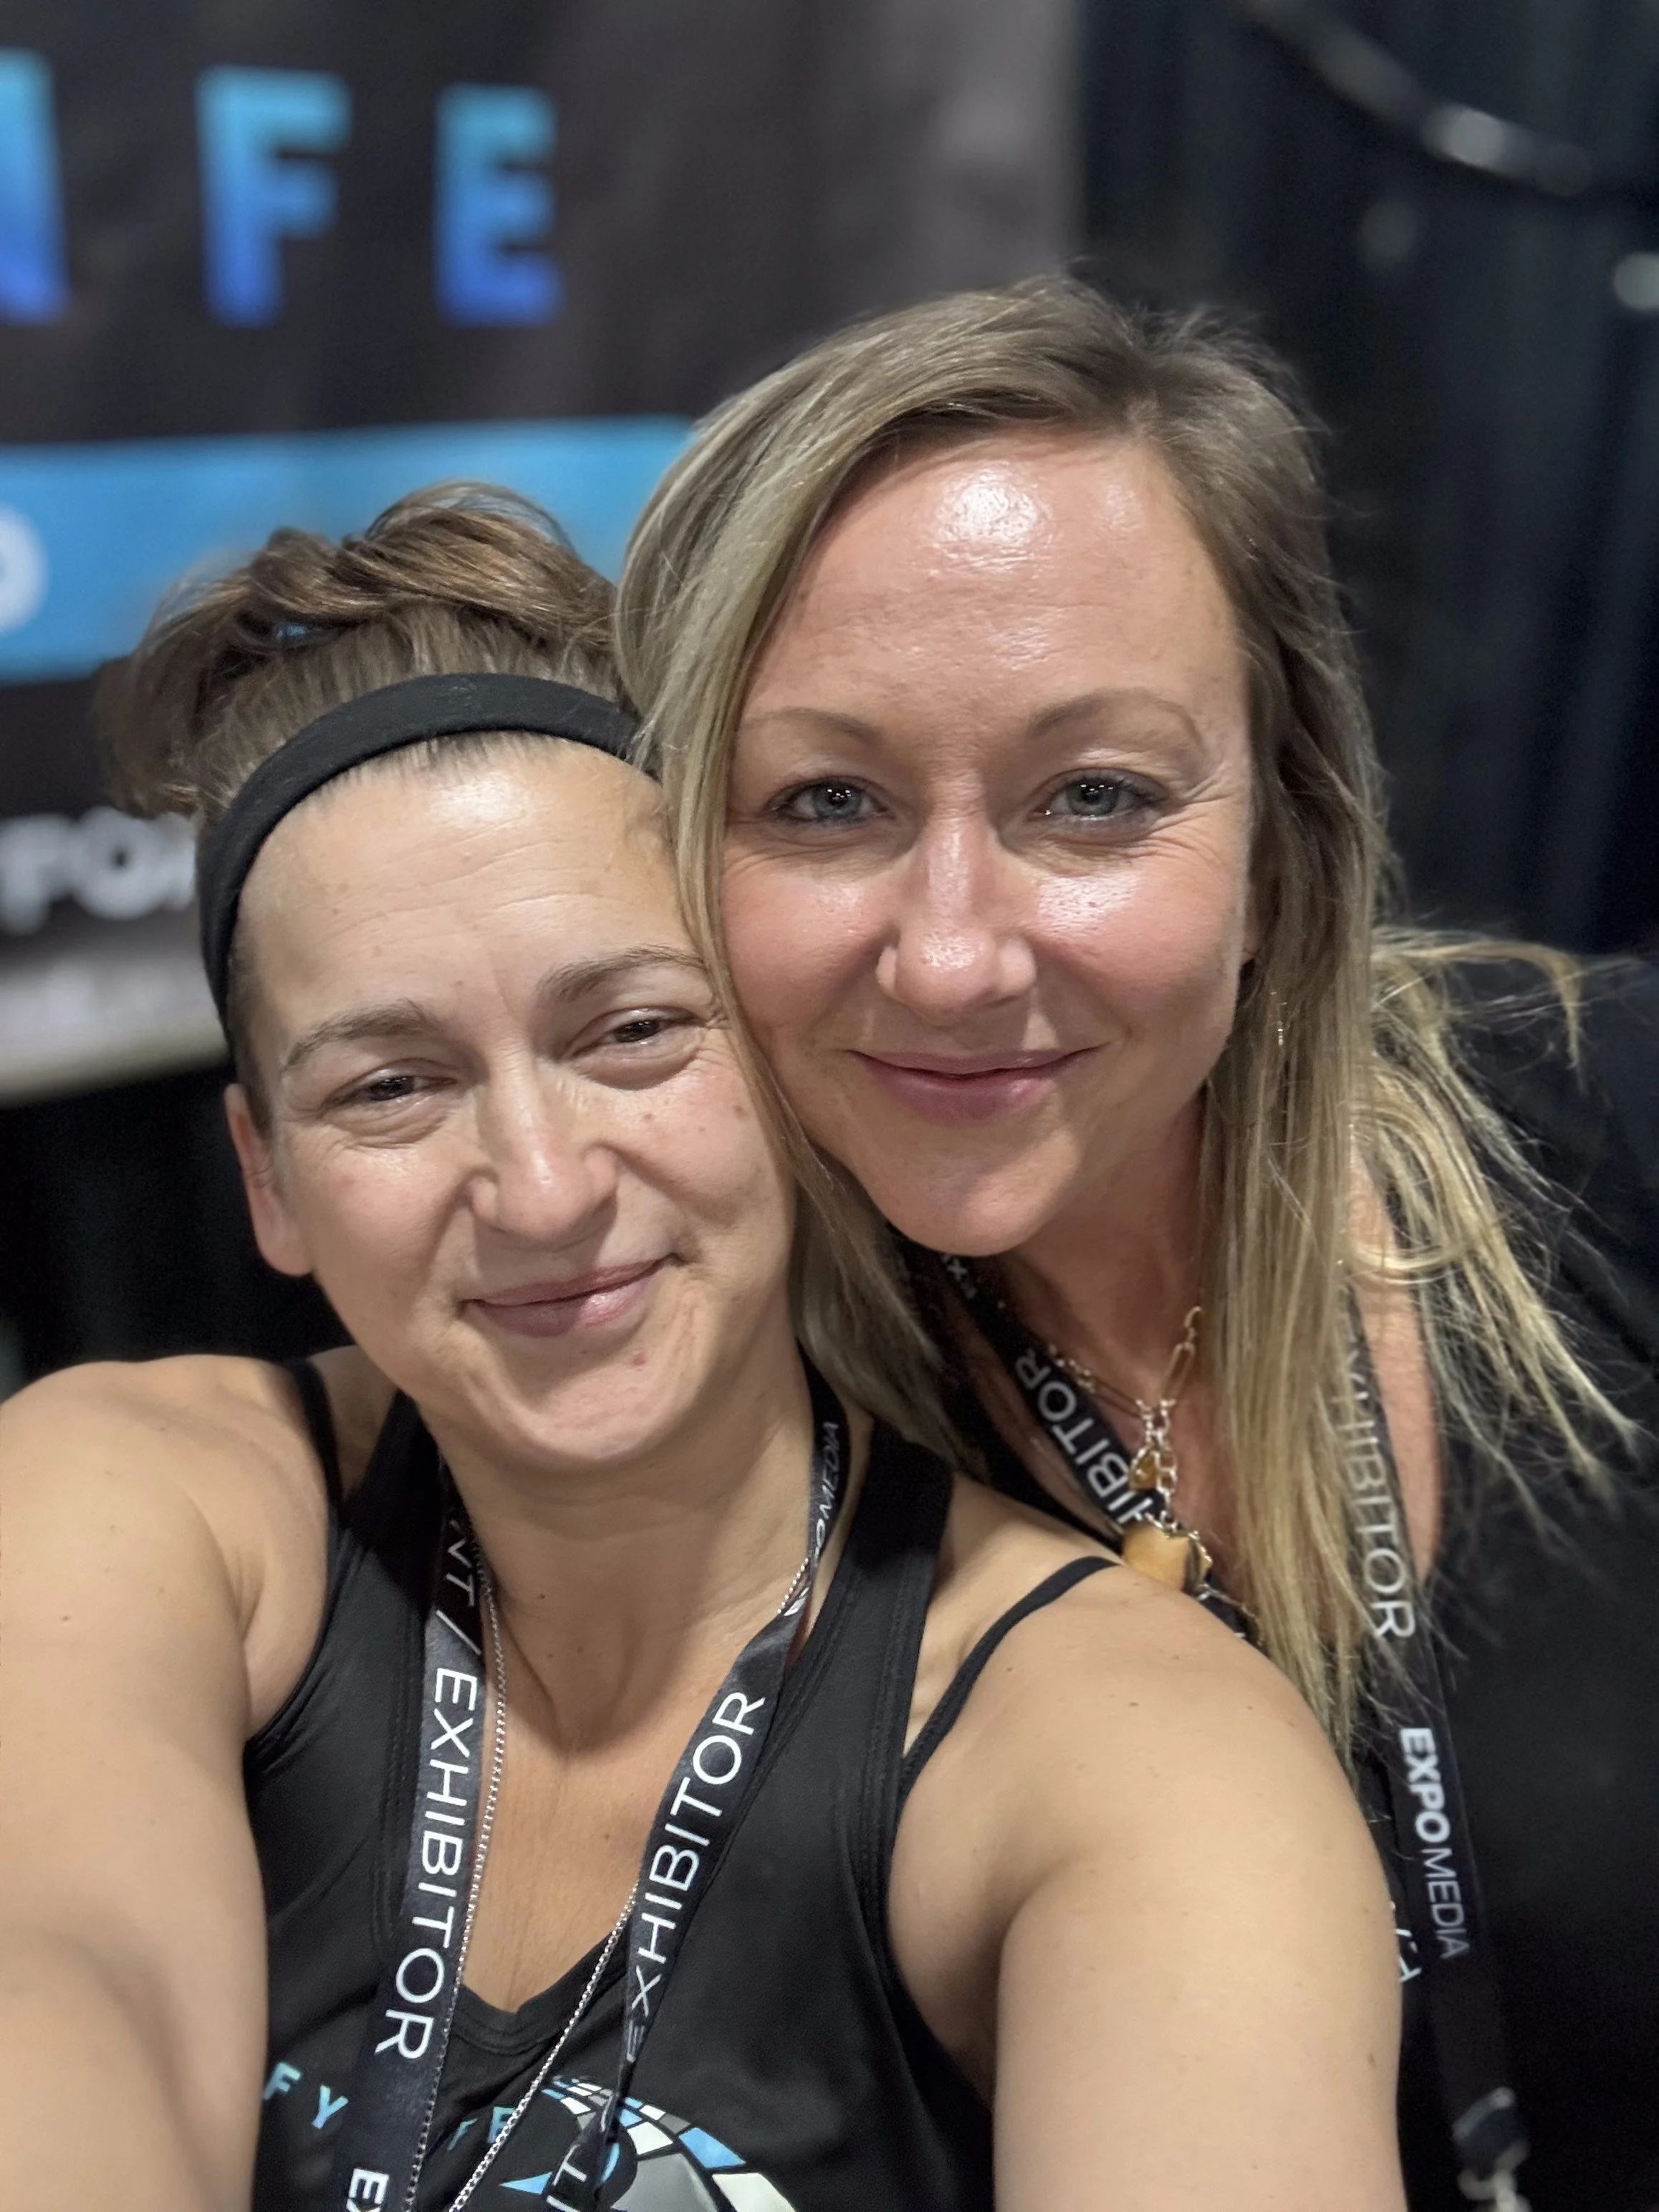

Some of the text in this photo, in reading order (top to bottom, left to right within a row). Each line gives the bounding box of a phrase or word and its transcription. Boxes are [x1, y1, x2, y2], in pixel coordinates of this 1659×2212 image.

[375, 1667, 478, 2059] EXHIBITOR
[625, 1691, 765, 2063] EXHIBITOR
[1399, 1727, 1471, 1960] EXPOMEDIA
